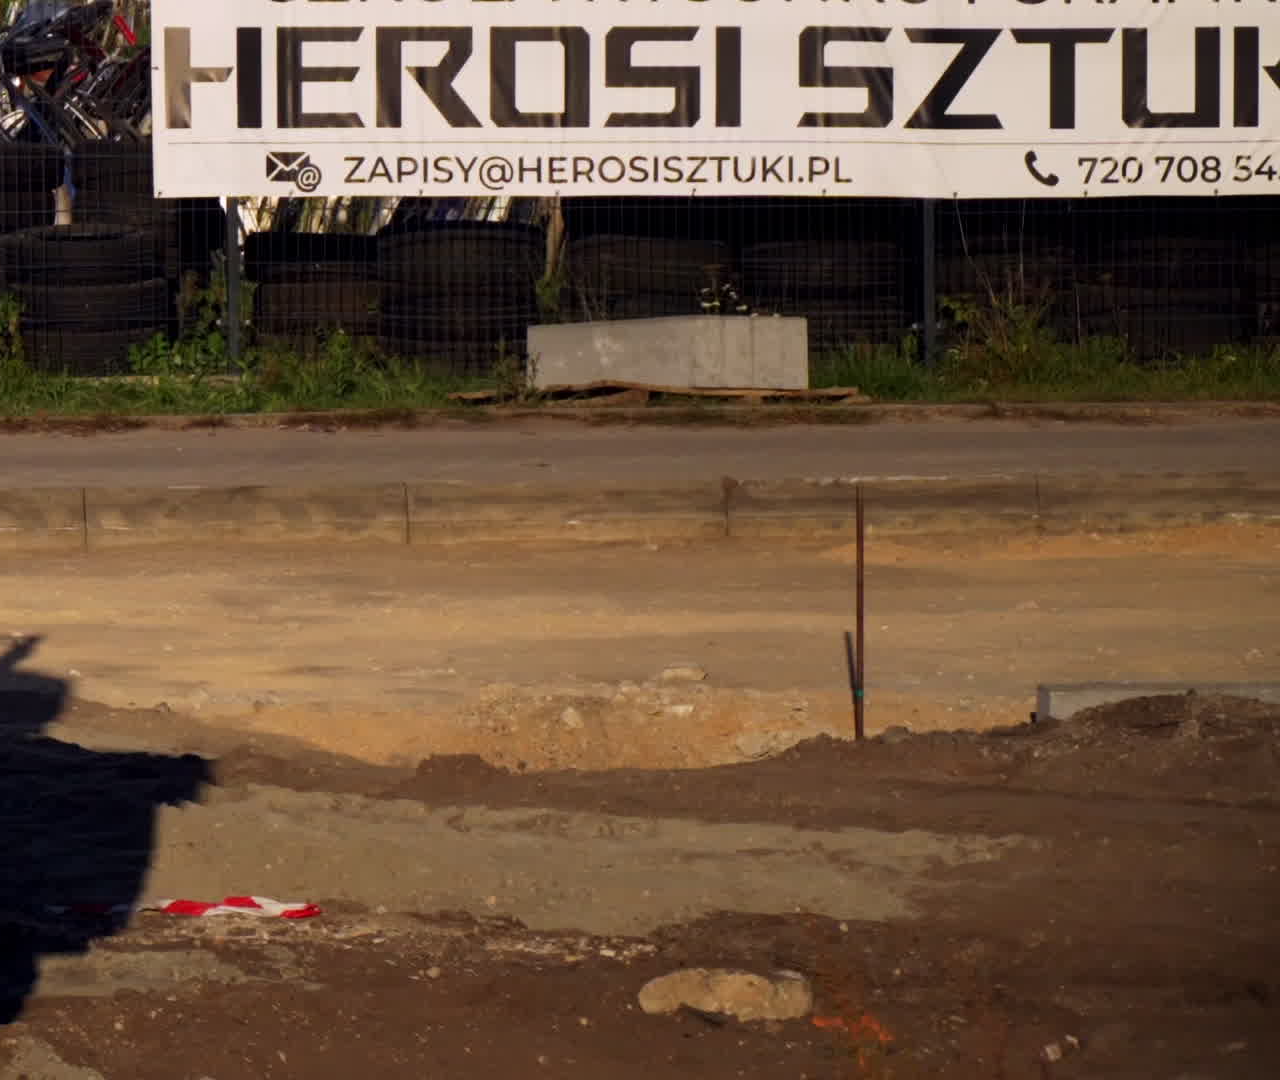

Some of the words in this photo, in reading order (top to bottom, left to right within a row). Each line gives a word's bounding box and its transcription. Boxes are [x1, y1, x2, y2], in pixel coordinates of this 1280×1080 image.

[164, 26, 742, 128] HEROSI
[343, 155, 853, 190] ZAPISY@HEROSISZTUKI.PL
[1078, 156, 1143, 183] 720
[1155, 156, 1222, 183] 708
[1233, 155, 1280, 183] 54
